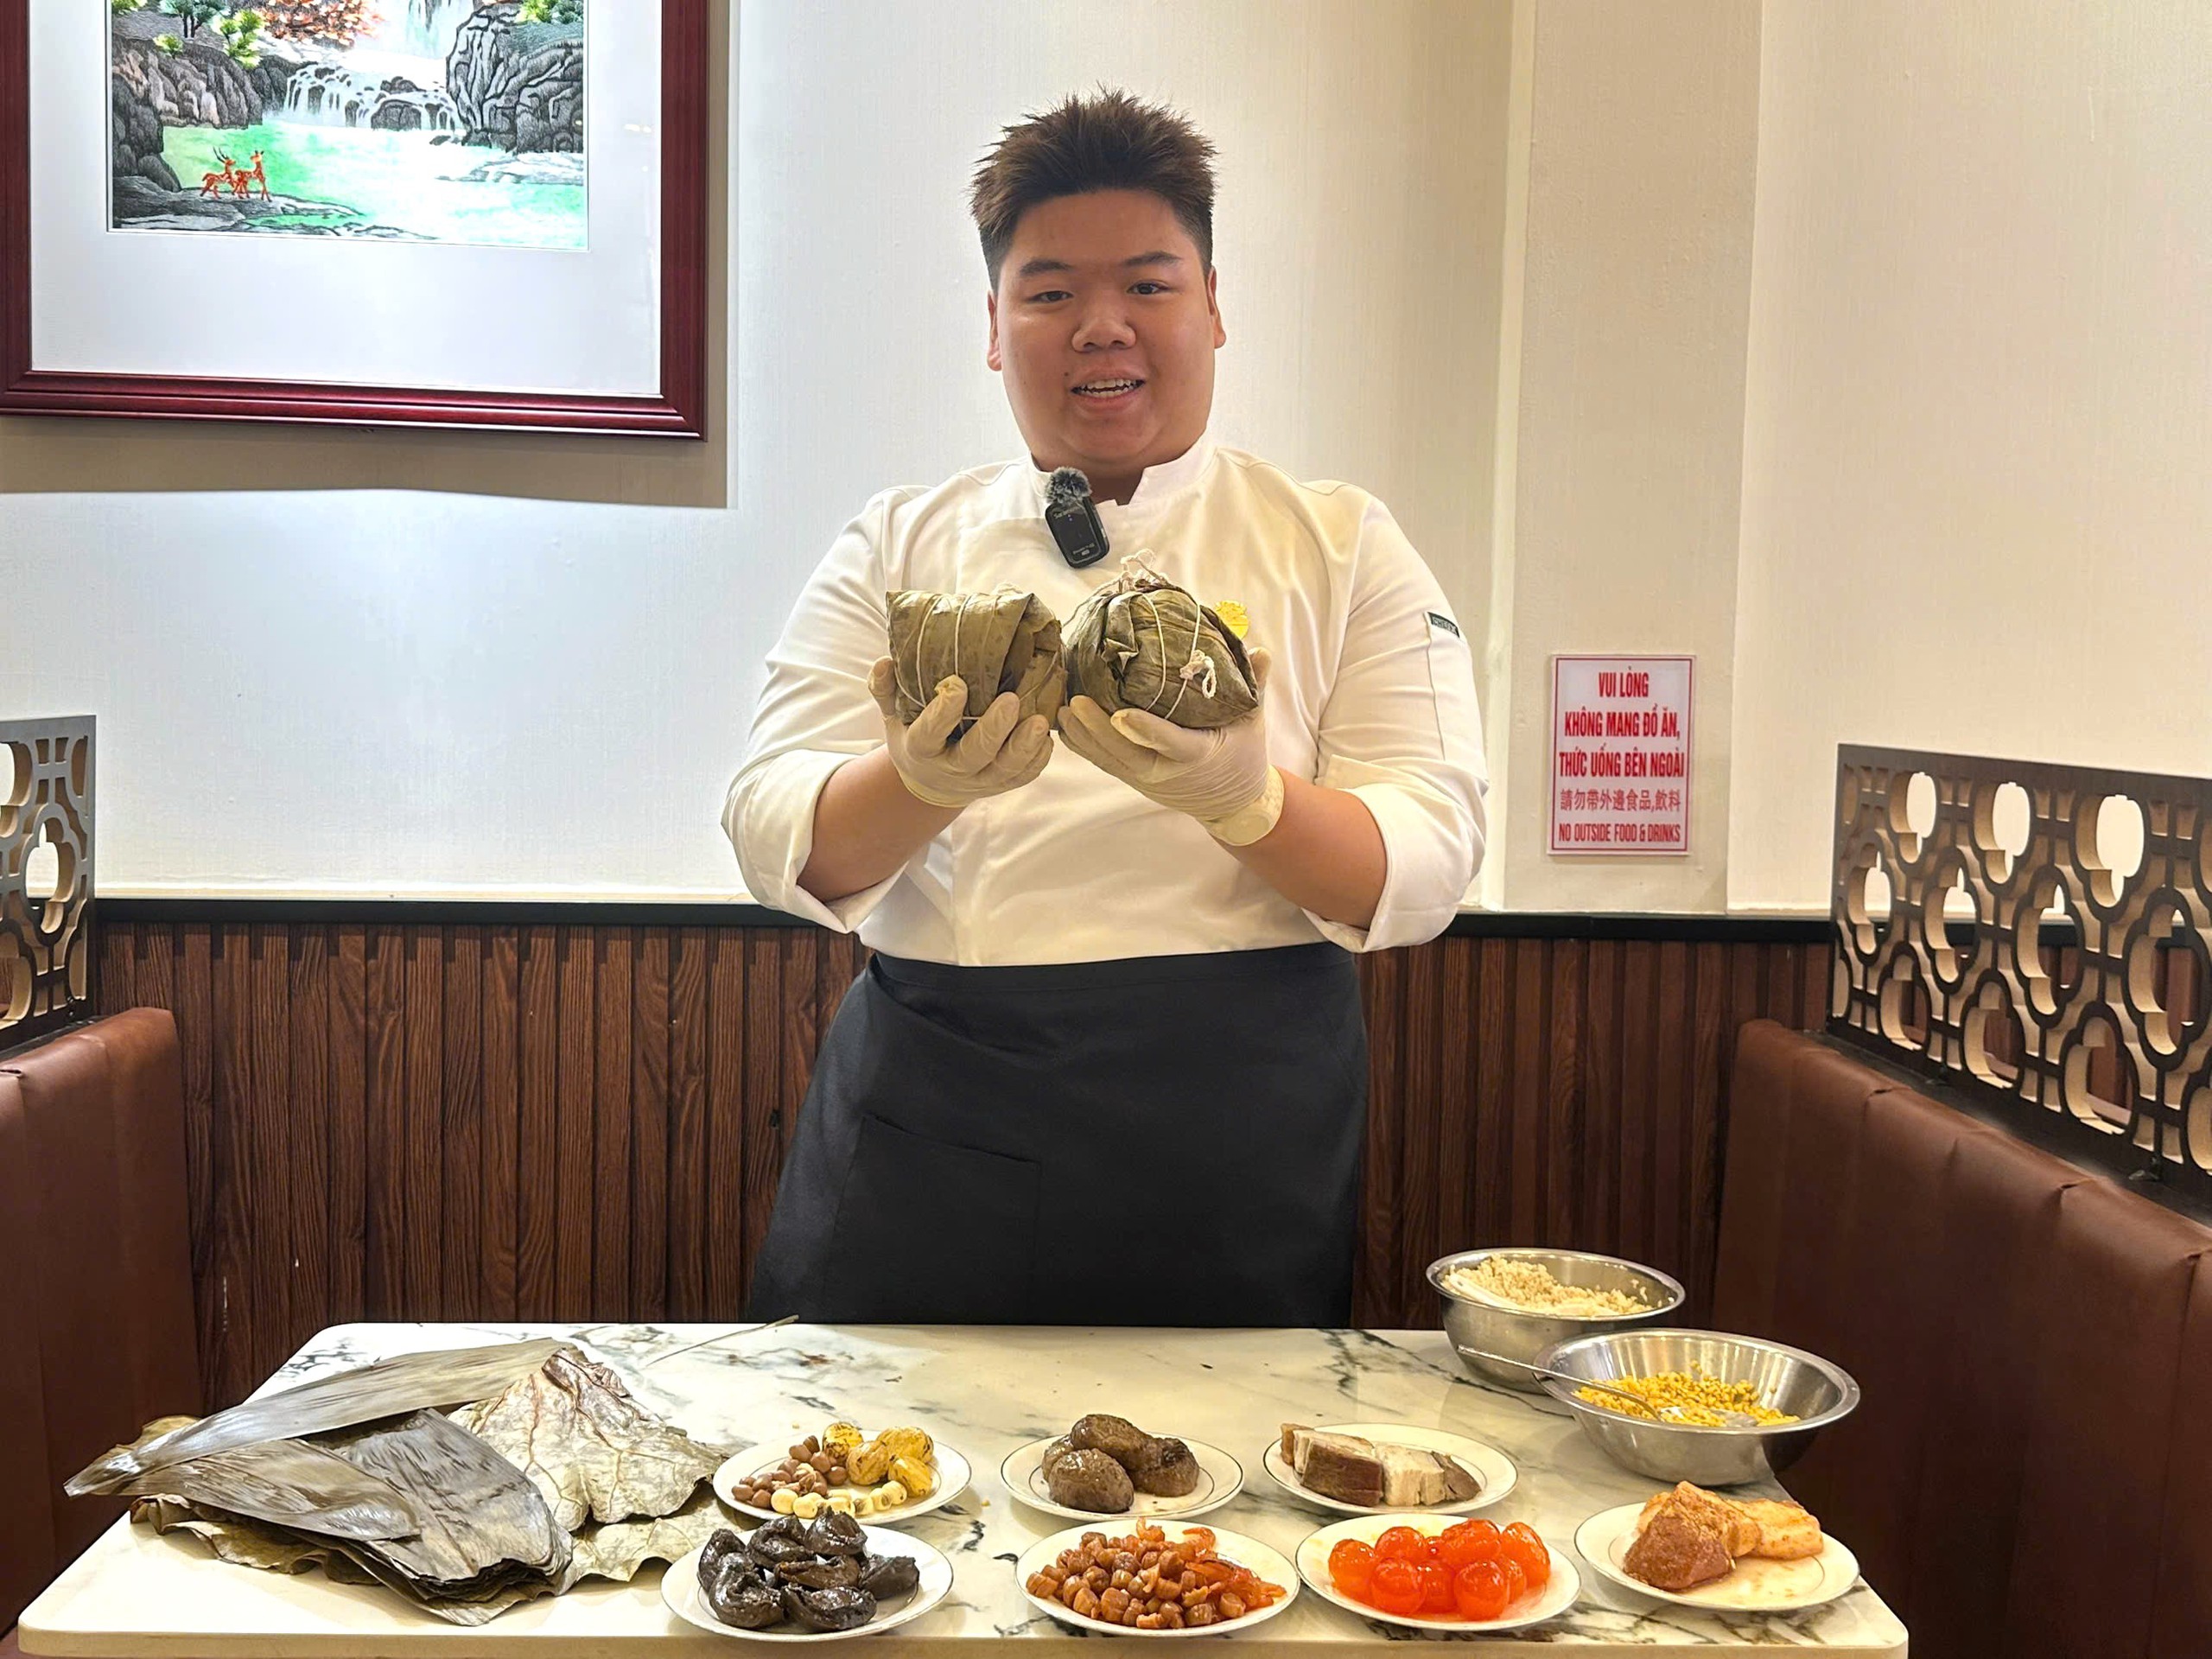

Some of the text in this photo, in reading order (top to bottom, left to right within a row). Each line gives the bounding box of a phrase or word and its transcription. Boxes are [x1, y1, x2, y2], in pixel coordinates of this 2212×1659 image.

[1599, 665, 1649, 697] VUI LÒNG
[1565, 706, 1603, 737] KHÔNG
[1605, 711, 1639, 737] MANG
[1661, 707, 1680, 741] ĂN,
[1559, 742, 1684, 777] THỨC UỐNG BÊN NGOÀI
[1559, 823, 1681, 842] NO OUTSIDE FOOD & DRINKS
